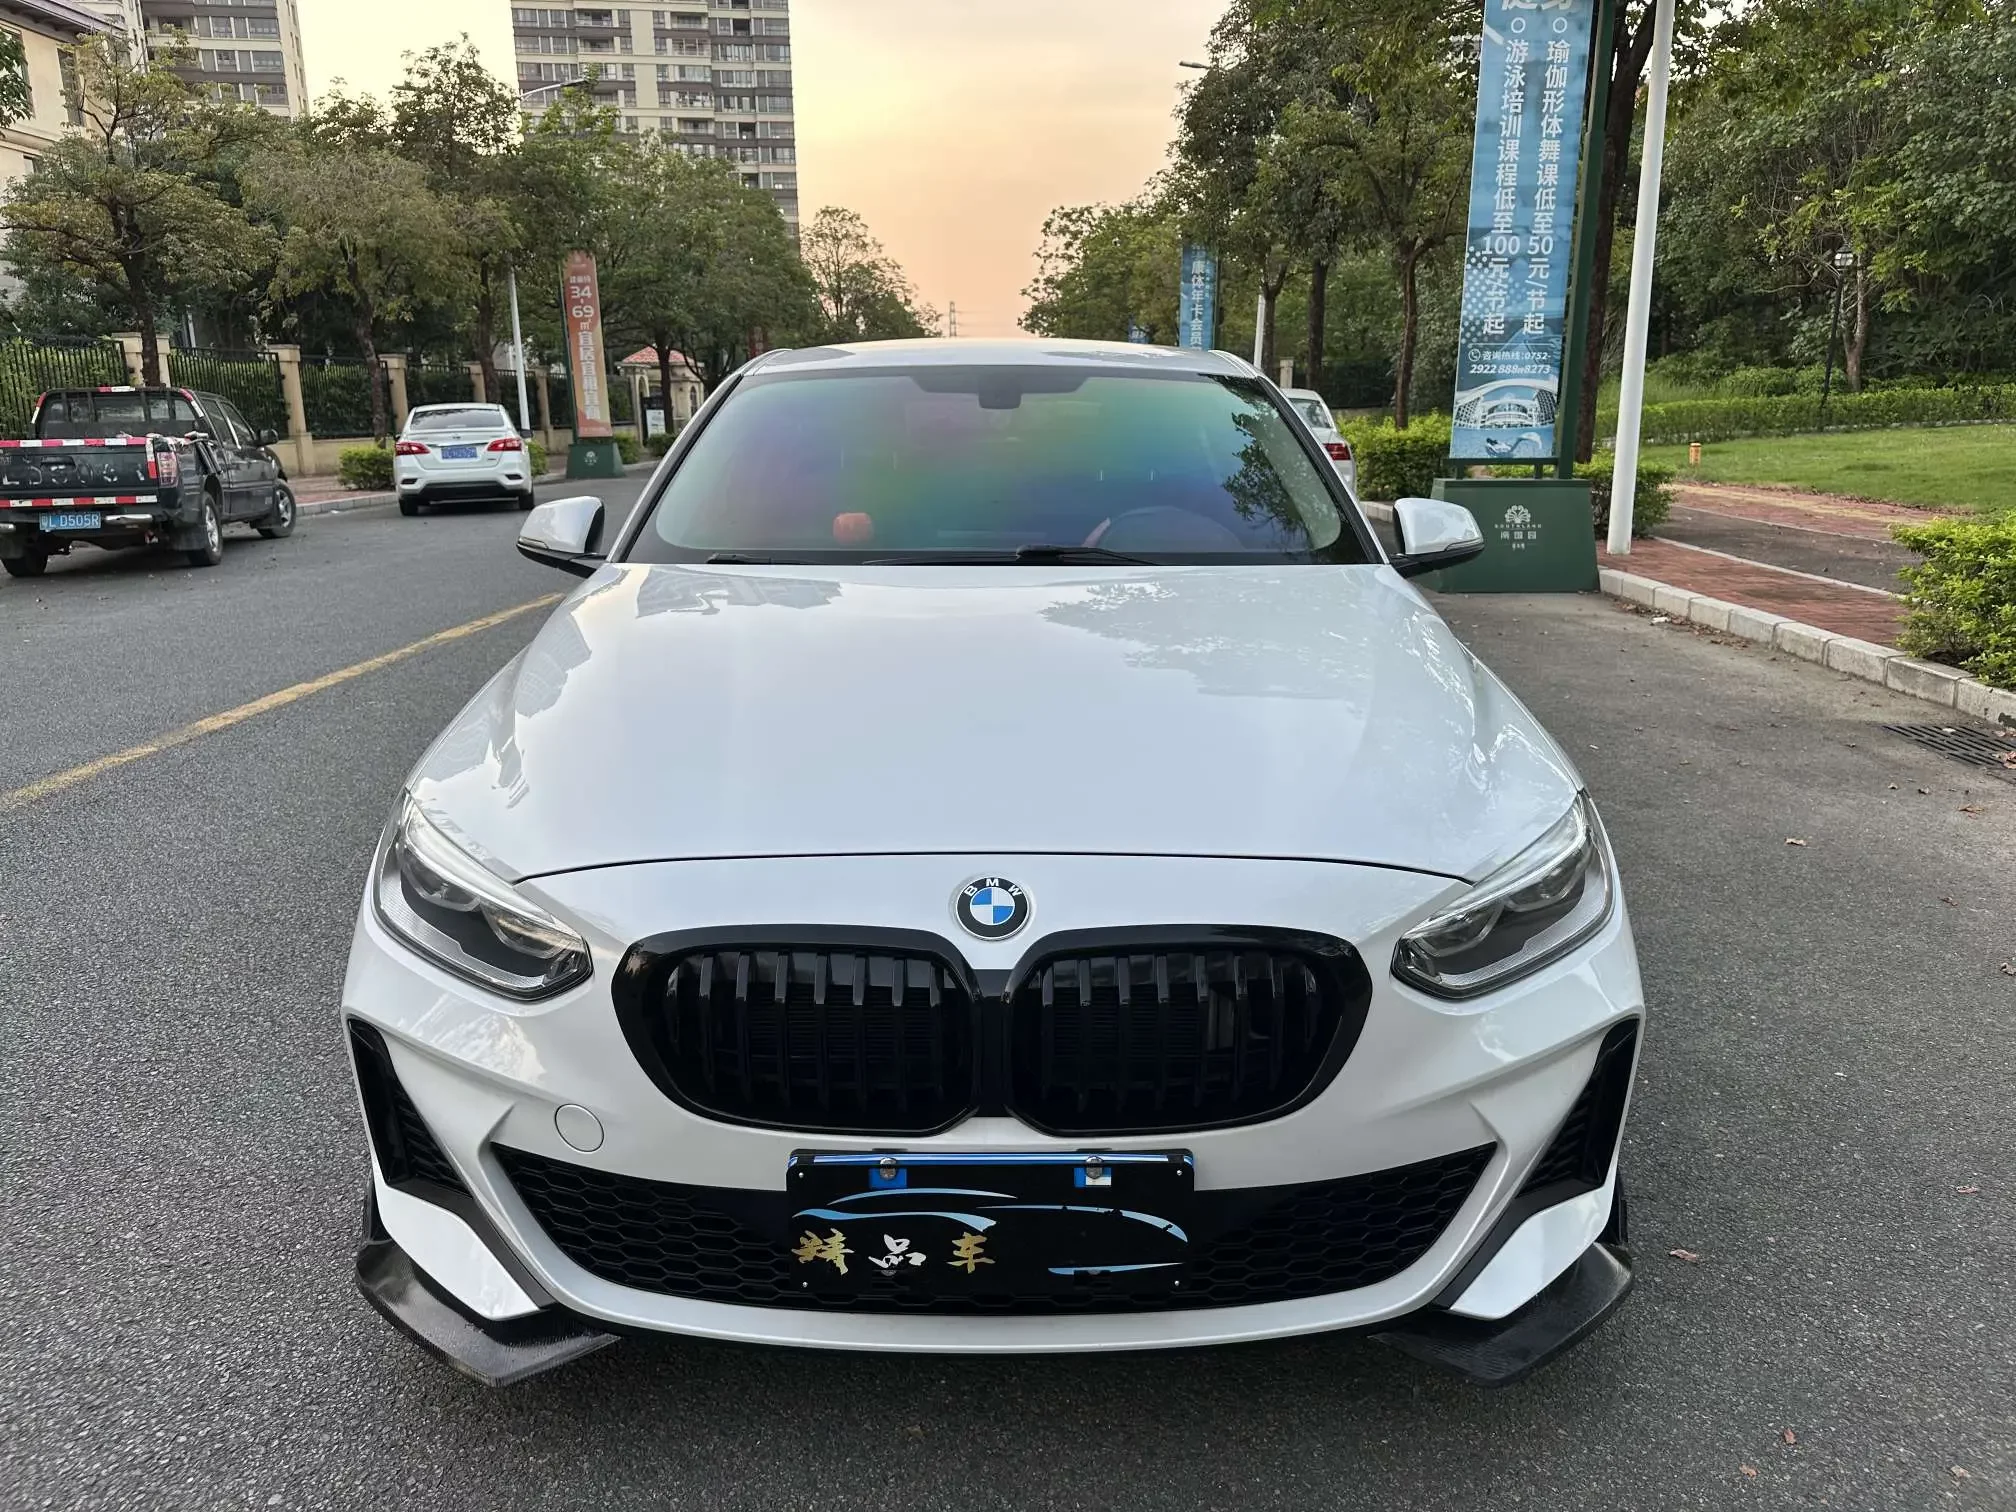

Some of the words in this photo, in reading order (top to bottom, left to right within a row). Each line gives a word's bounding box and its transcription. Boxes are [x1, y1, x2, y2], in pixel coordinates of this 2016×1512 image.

[570, 286, 592, 299] 34
[572, 305, 594, 318] 69
[963, 878, 1023, 897] BMW
